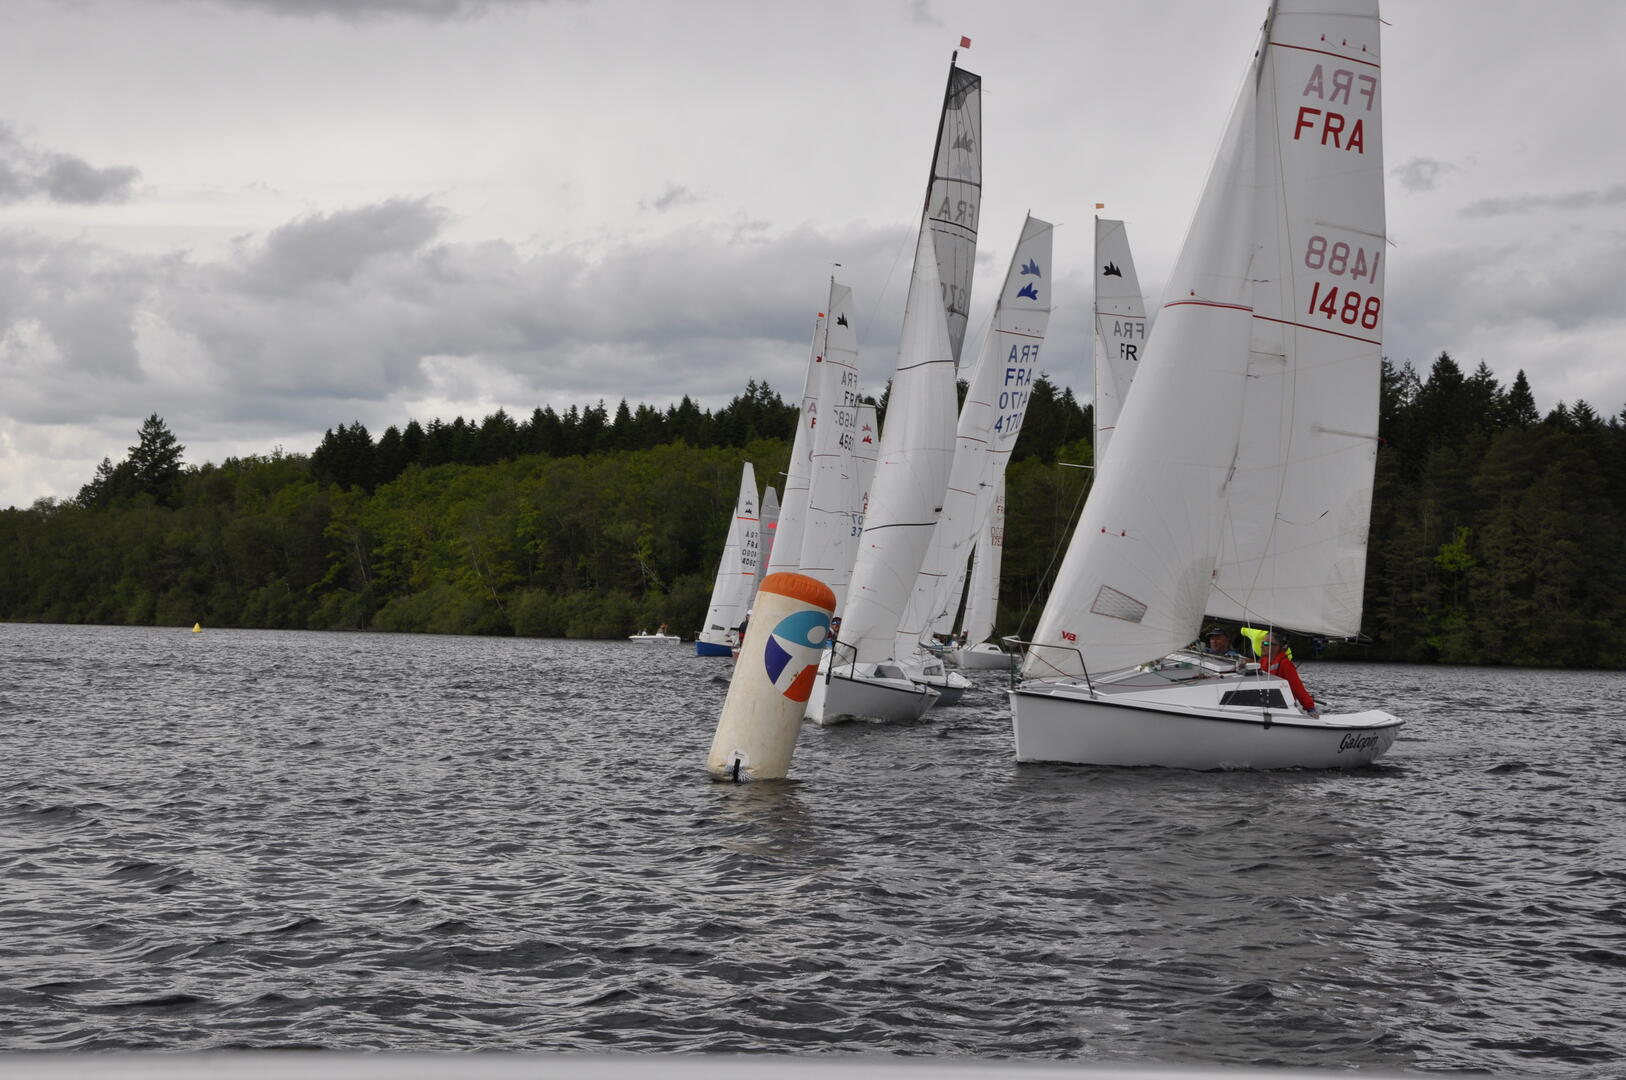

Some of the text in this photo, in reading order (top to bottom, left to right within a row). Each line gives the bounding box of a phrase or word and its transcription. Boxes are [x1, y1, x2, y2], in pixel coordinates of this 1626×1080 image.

[1294, 106, 1364, 154] FRA
[1308, 282, 1380, 329] 1488
[1005, 367, 1032, 387] FRA
